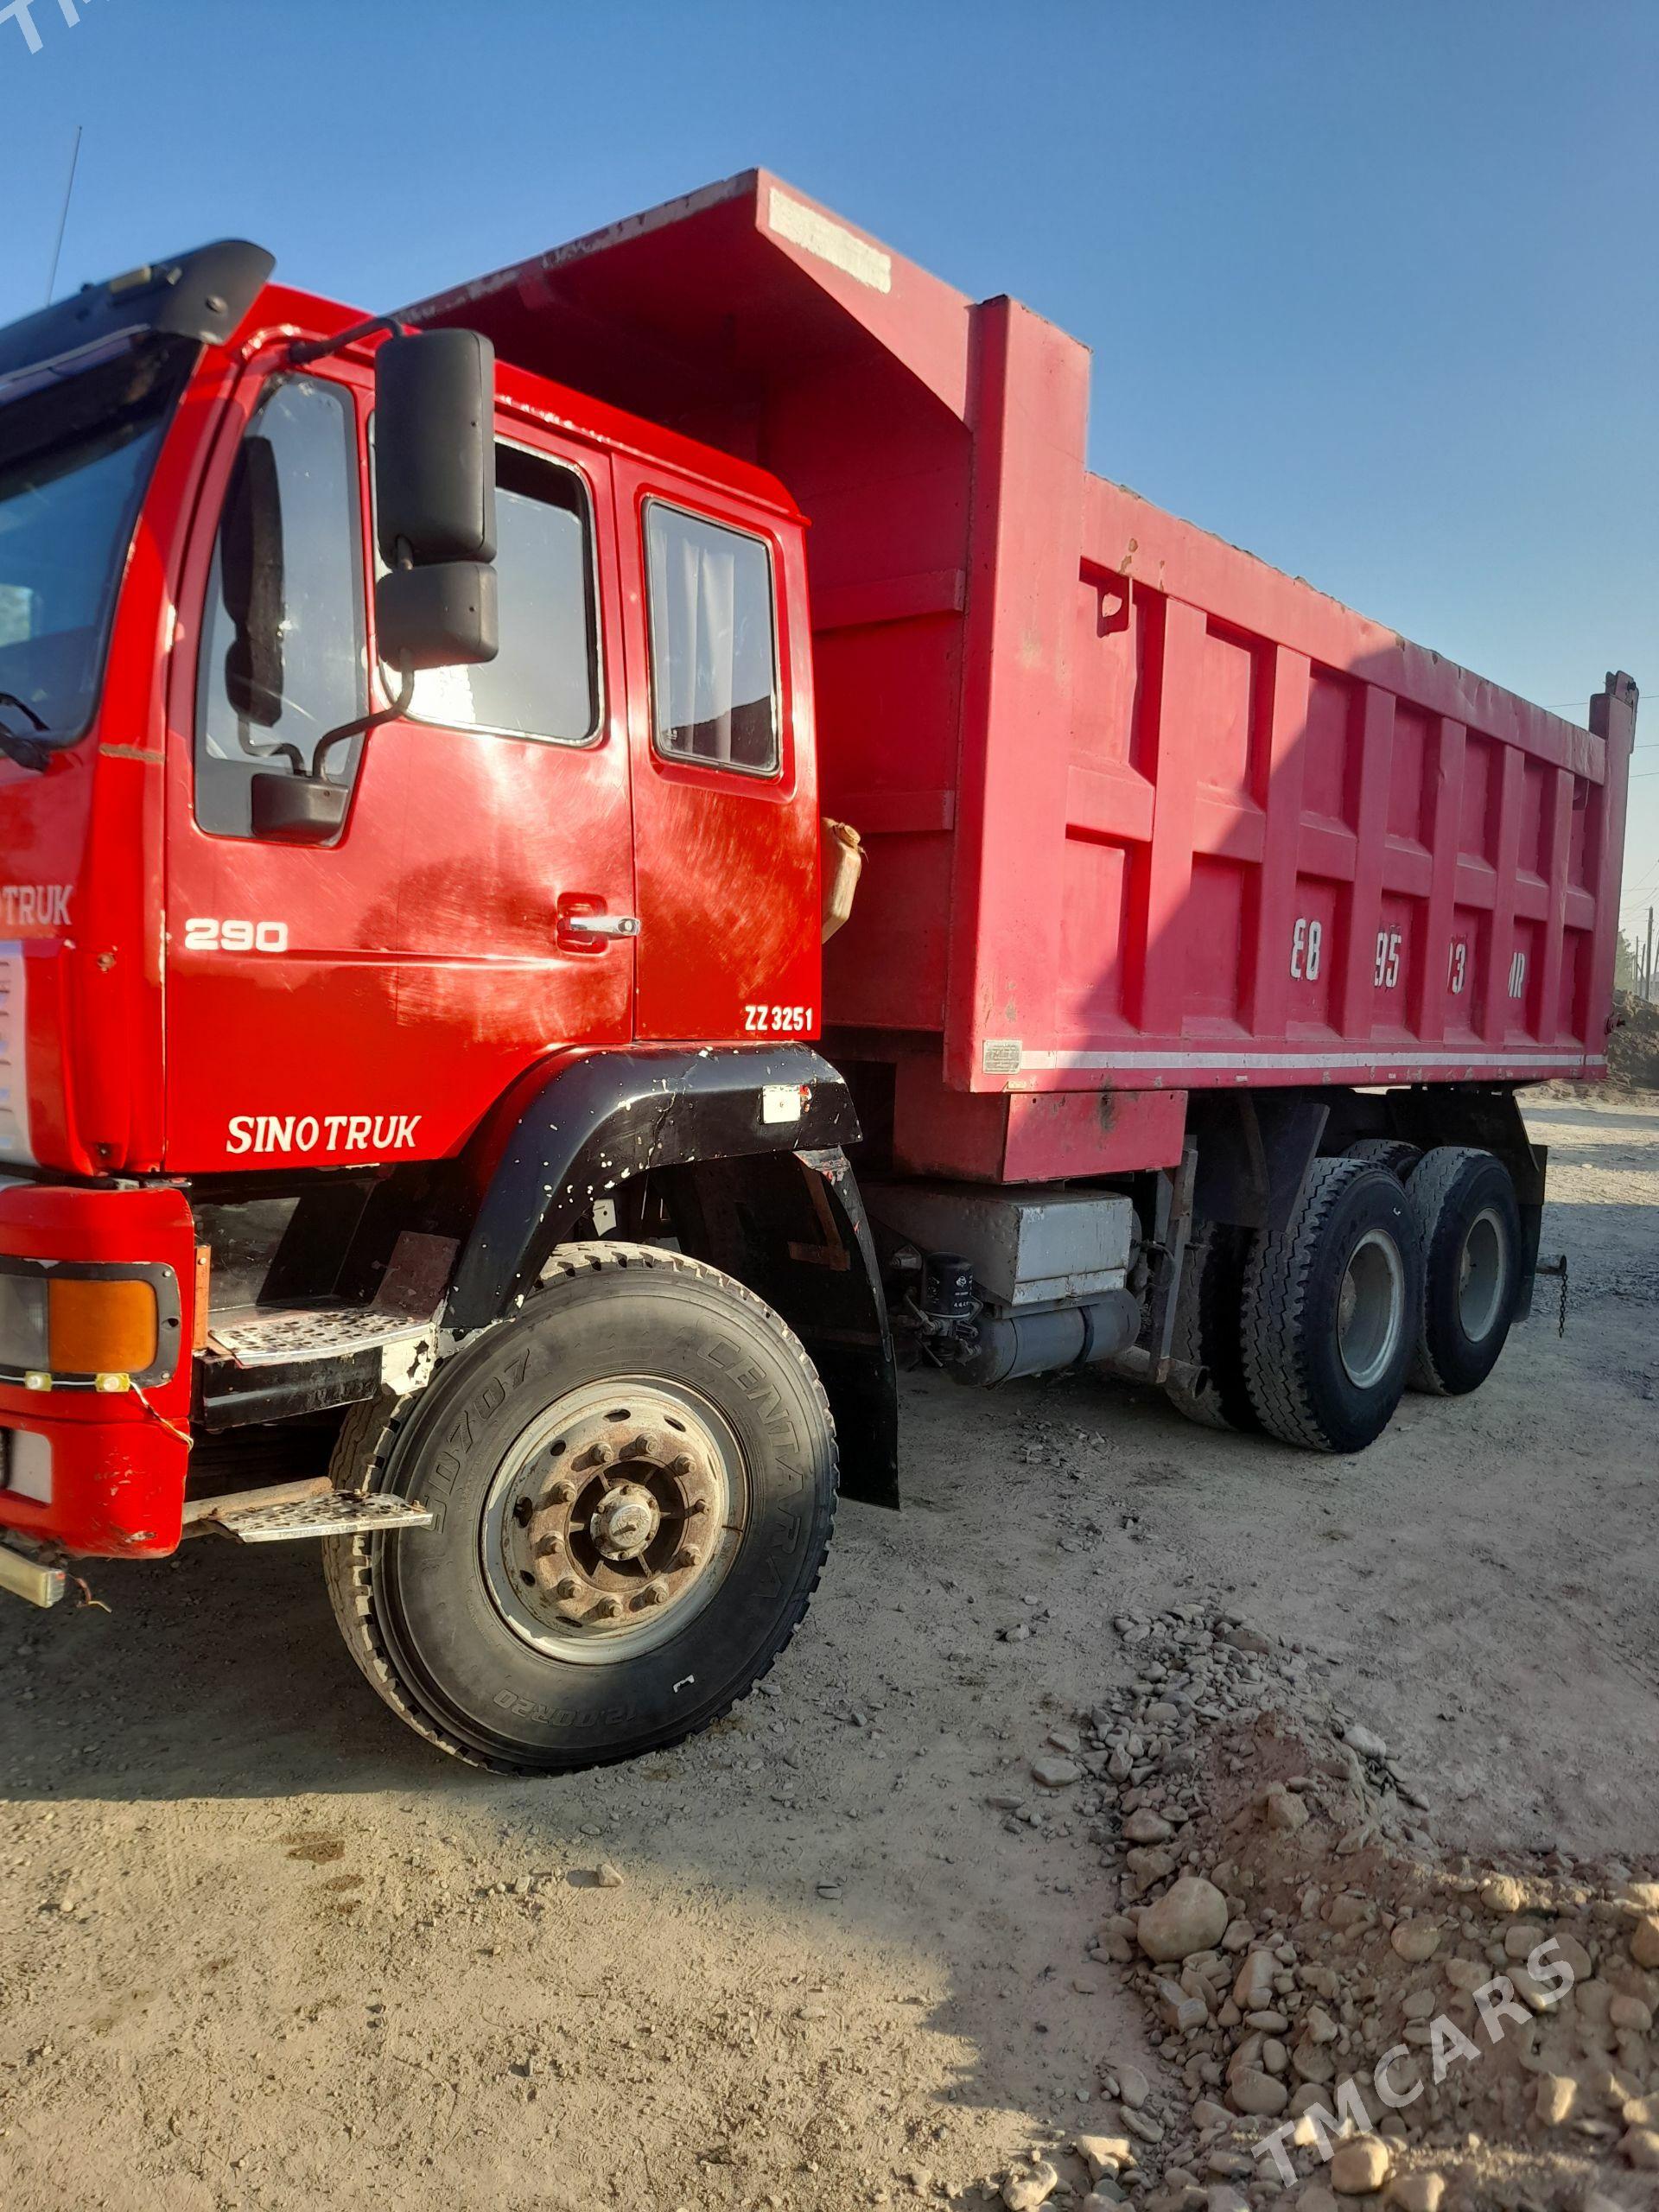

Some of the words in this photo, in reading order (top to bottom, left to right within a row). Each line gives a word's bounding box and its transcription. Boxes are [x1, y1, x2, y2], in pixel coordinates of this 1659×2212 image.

[2, 885, 73, 926] TRUK
[184, 918, 289, 952] 290
[1374, 931, 1402, 988] 95
[745, 1005, 768, 1031] ZZ
[771, 1006, 812, 1031] 3251
[226, 1116, 423, 1154] SINOTRUK
[696, 1332, 804, 1600] CENTARA
